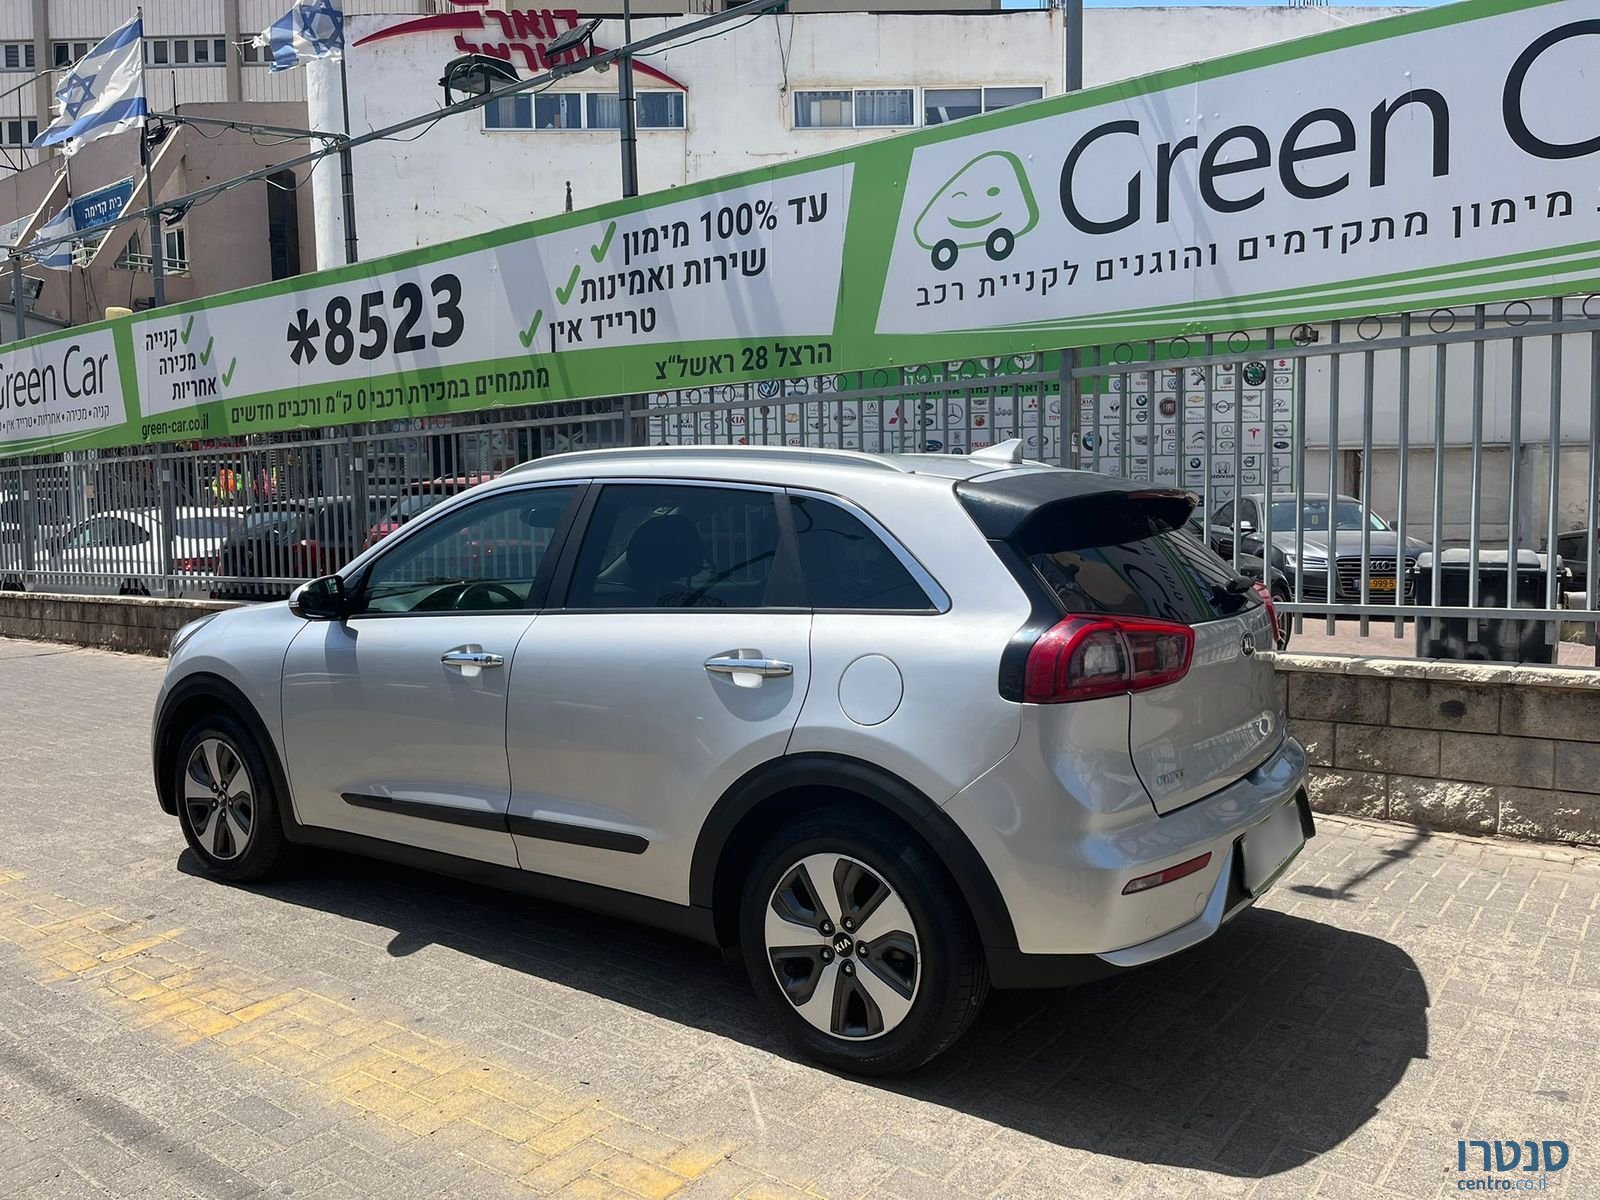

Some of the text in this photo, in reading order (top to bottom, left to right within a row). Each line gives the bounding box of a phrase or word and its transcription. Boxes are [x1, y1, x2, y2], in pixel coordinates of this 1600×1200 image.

[485, 9, 578, 39] דואר
[1059, 88, 1450, 235] Green
[84, 196, 122, 219] בית קדימה
[623, 192, 828, 266] עד 100% מימון
[916, 190, 1573, 307] מימון מתקדמים והוגנים לקניית רכב
[580, 247, 767, 304] שירות ואמינות
[145, 328, 178, 352] קנייה
[549, 306, 656, 353] טרייד אין
[159, 352, 196, 376] מכירה
[741, 345, 768, 372] 28
[775, 342, 832, 369] הרצל
[0, 345, 108, 410] reen Car
[172, 376, 217, 400] אחריות
[475, 367, 550, 396] מתמחים
[357, 388, 367, 411] 0
[371, 388, 404, 411] רכבי
[408, 377, 469, 405] במכירת
[37, 412, 61, 427] אחריות
[66, 408, 87, 423] מכירה
[93, 405, 110, 421] קניה
[231, 402, 274, 424] חדשים
[278, 396, 320, 419] ורכבים
[141, 413, 209, 440] green-car.co.il
[834, 938, 852, 953] KIA
